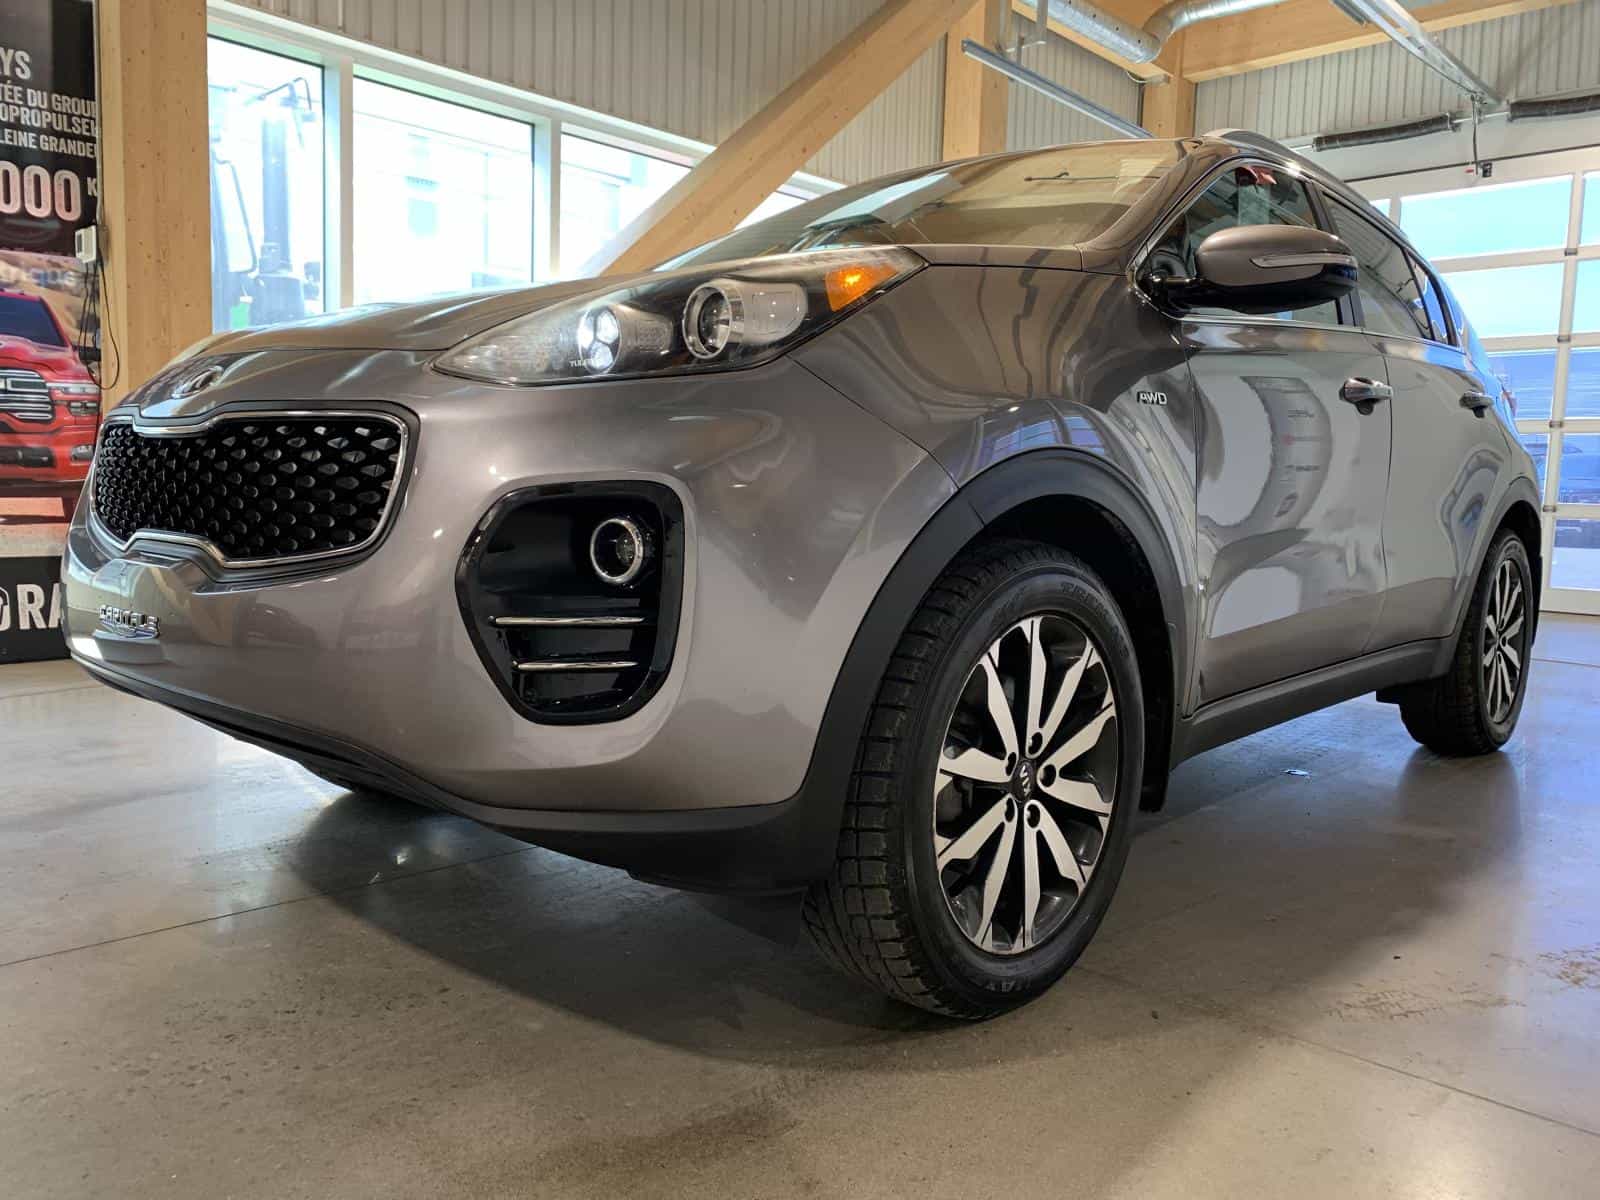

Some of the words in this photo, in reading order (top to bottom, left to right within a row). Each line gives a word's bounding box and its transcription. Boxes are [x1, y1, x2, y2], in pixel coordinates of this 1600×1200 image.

[0, 46, 31, 79] YS
[27, 88, 47, 109] DU
[1137, 391, 1168, 406] AWD
